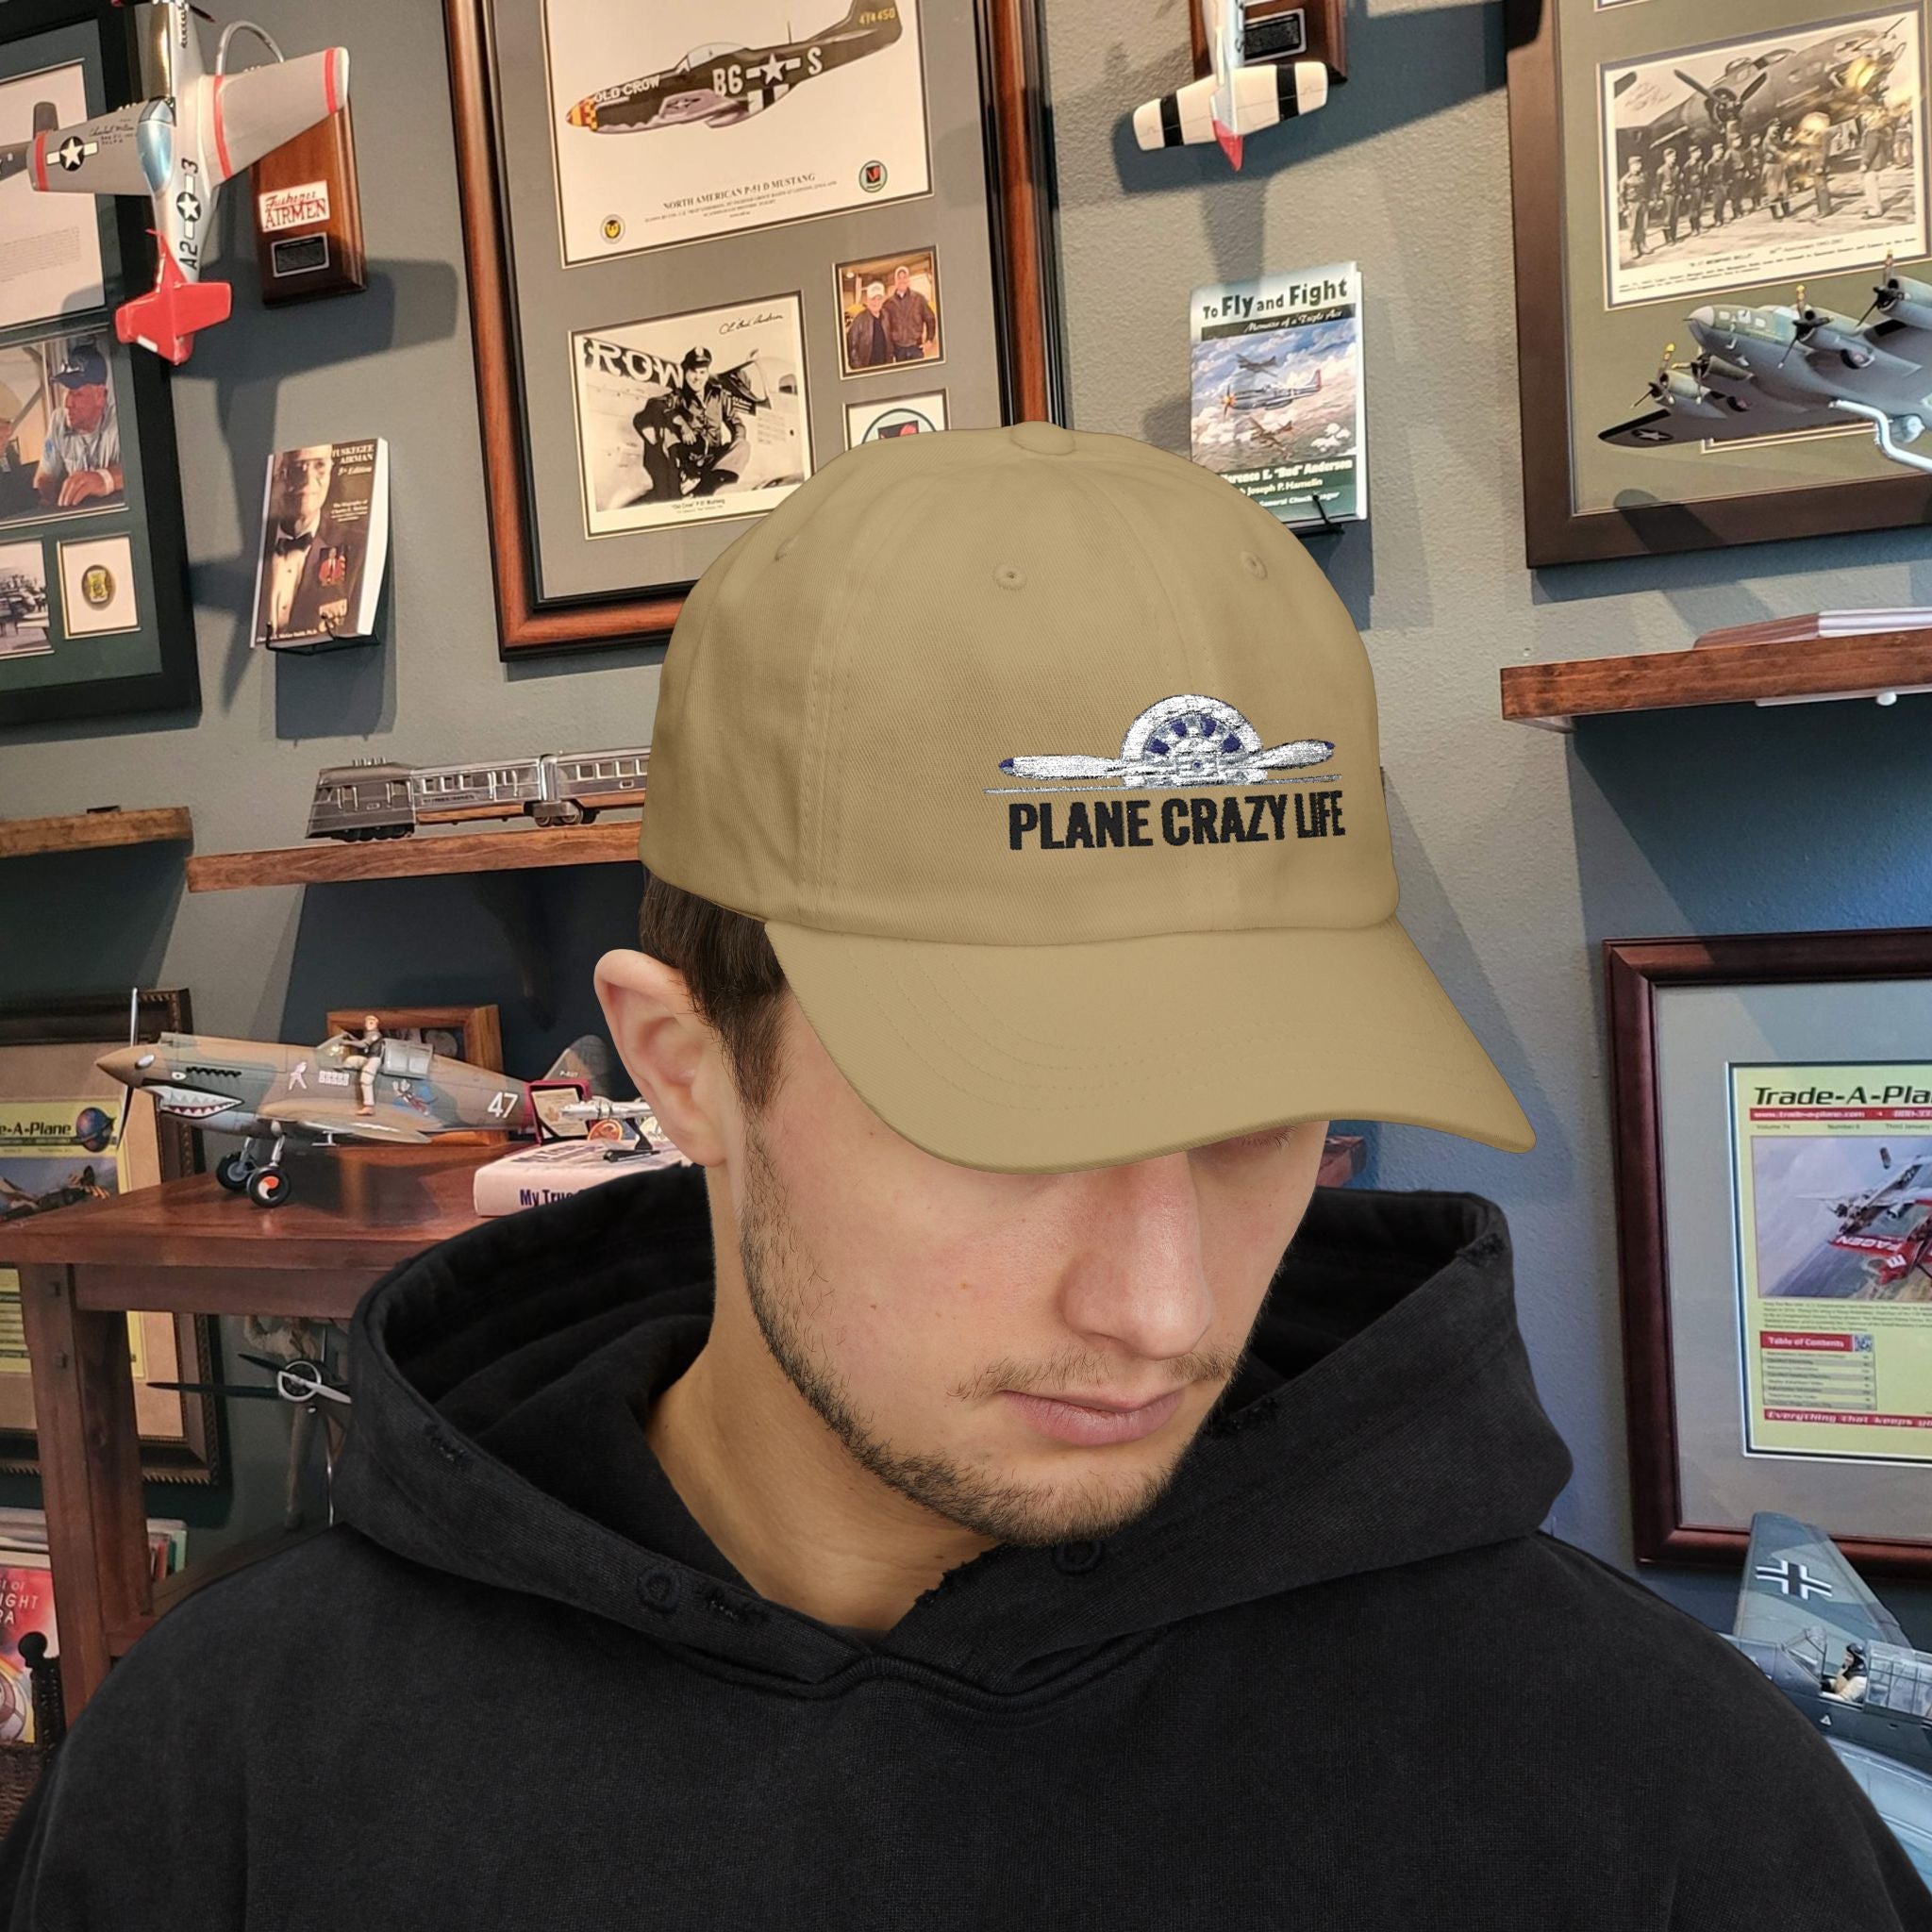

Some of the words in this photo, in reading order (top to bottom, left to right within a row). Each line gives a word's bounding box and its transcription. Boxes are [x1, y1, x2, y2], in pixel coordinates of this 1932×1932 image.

[712, 64, 743, 97] B6
[808, 47, 823, 75] S
[595, 87, 622, 103] OLD
[623, 75, 660, 95] CROW
[663, 195, 694, 209] NORTH
[695, 186, 743, 205] AMERICAN
[772, 173, 816, 190] MUSTANG
[264, 197, 327, 229] AIRMEN
[179, 241, 200, 271] A2
[1203, 306, 1218, 319] To
[1222, 294, 1254, 318] Fly
[1257, 294, 1284, 312] and
[1290, 278, 1347, 306] Fight
[341, 453, 374, 464] AIRMAN
[1303, 459, 1353, 475] Anderson
[1247, 484, 1275, 497] Joseph
[1009, 799, 1154, 850] PLANE
[1161, 793, 1289, 846] CRAZY
[1294, 790, 1346, 839] LIFE
[488, 1091, 519, 1119] 47
[520, 1189, 539, 1207] My
[1767, 1336, 1792, 1346] Table
[1805, 1338, 1844, 1349] Contents
[1768, 1410, 1837, 1424] Everything
